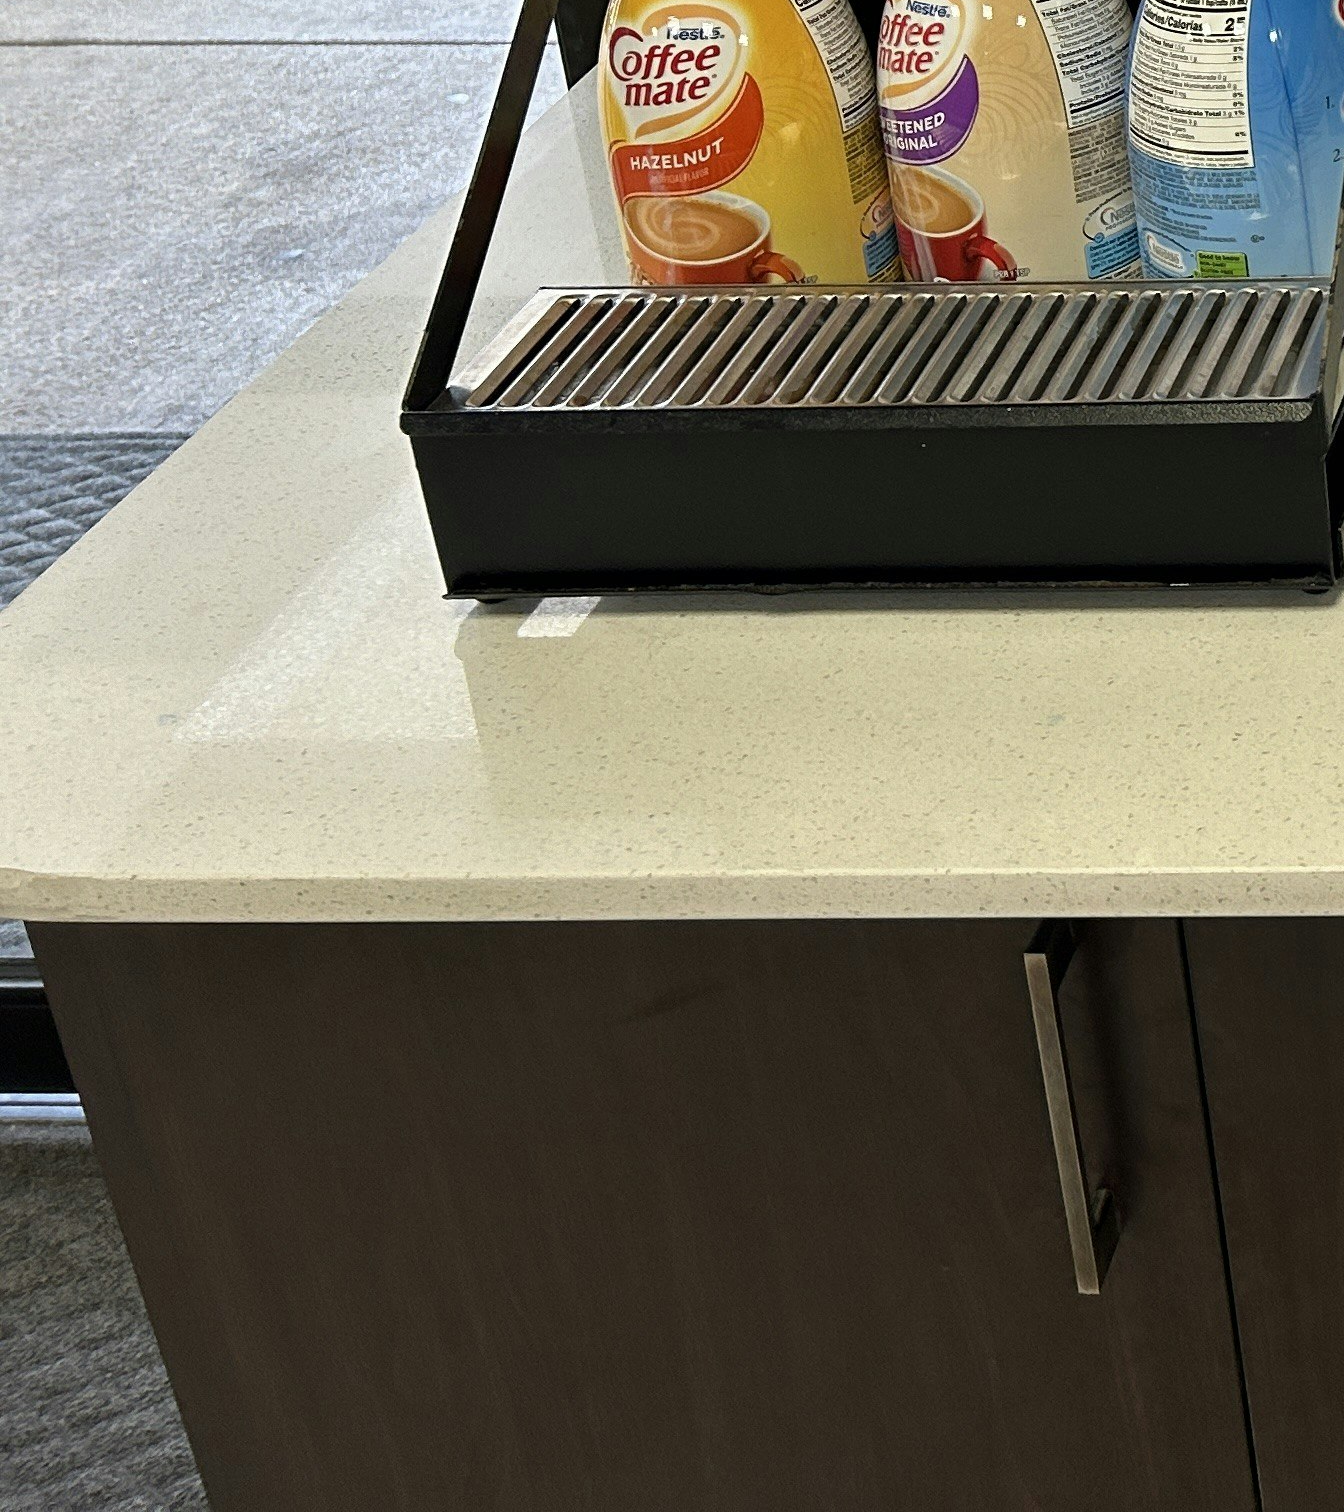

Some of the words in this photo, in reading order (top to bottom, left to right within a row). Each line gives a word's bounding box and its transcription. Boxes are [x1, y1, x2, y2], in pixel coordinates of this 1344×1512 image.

[881, 13, 945, 46] offee
[609, 26, 721, 81] Coffee
[879, 47, 933, 74] mate
[624, 74, 711, 107] mate
[630, 137, 725, 170] HAZELNUT
